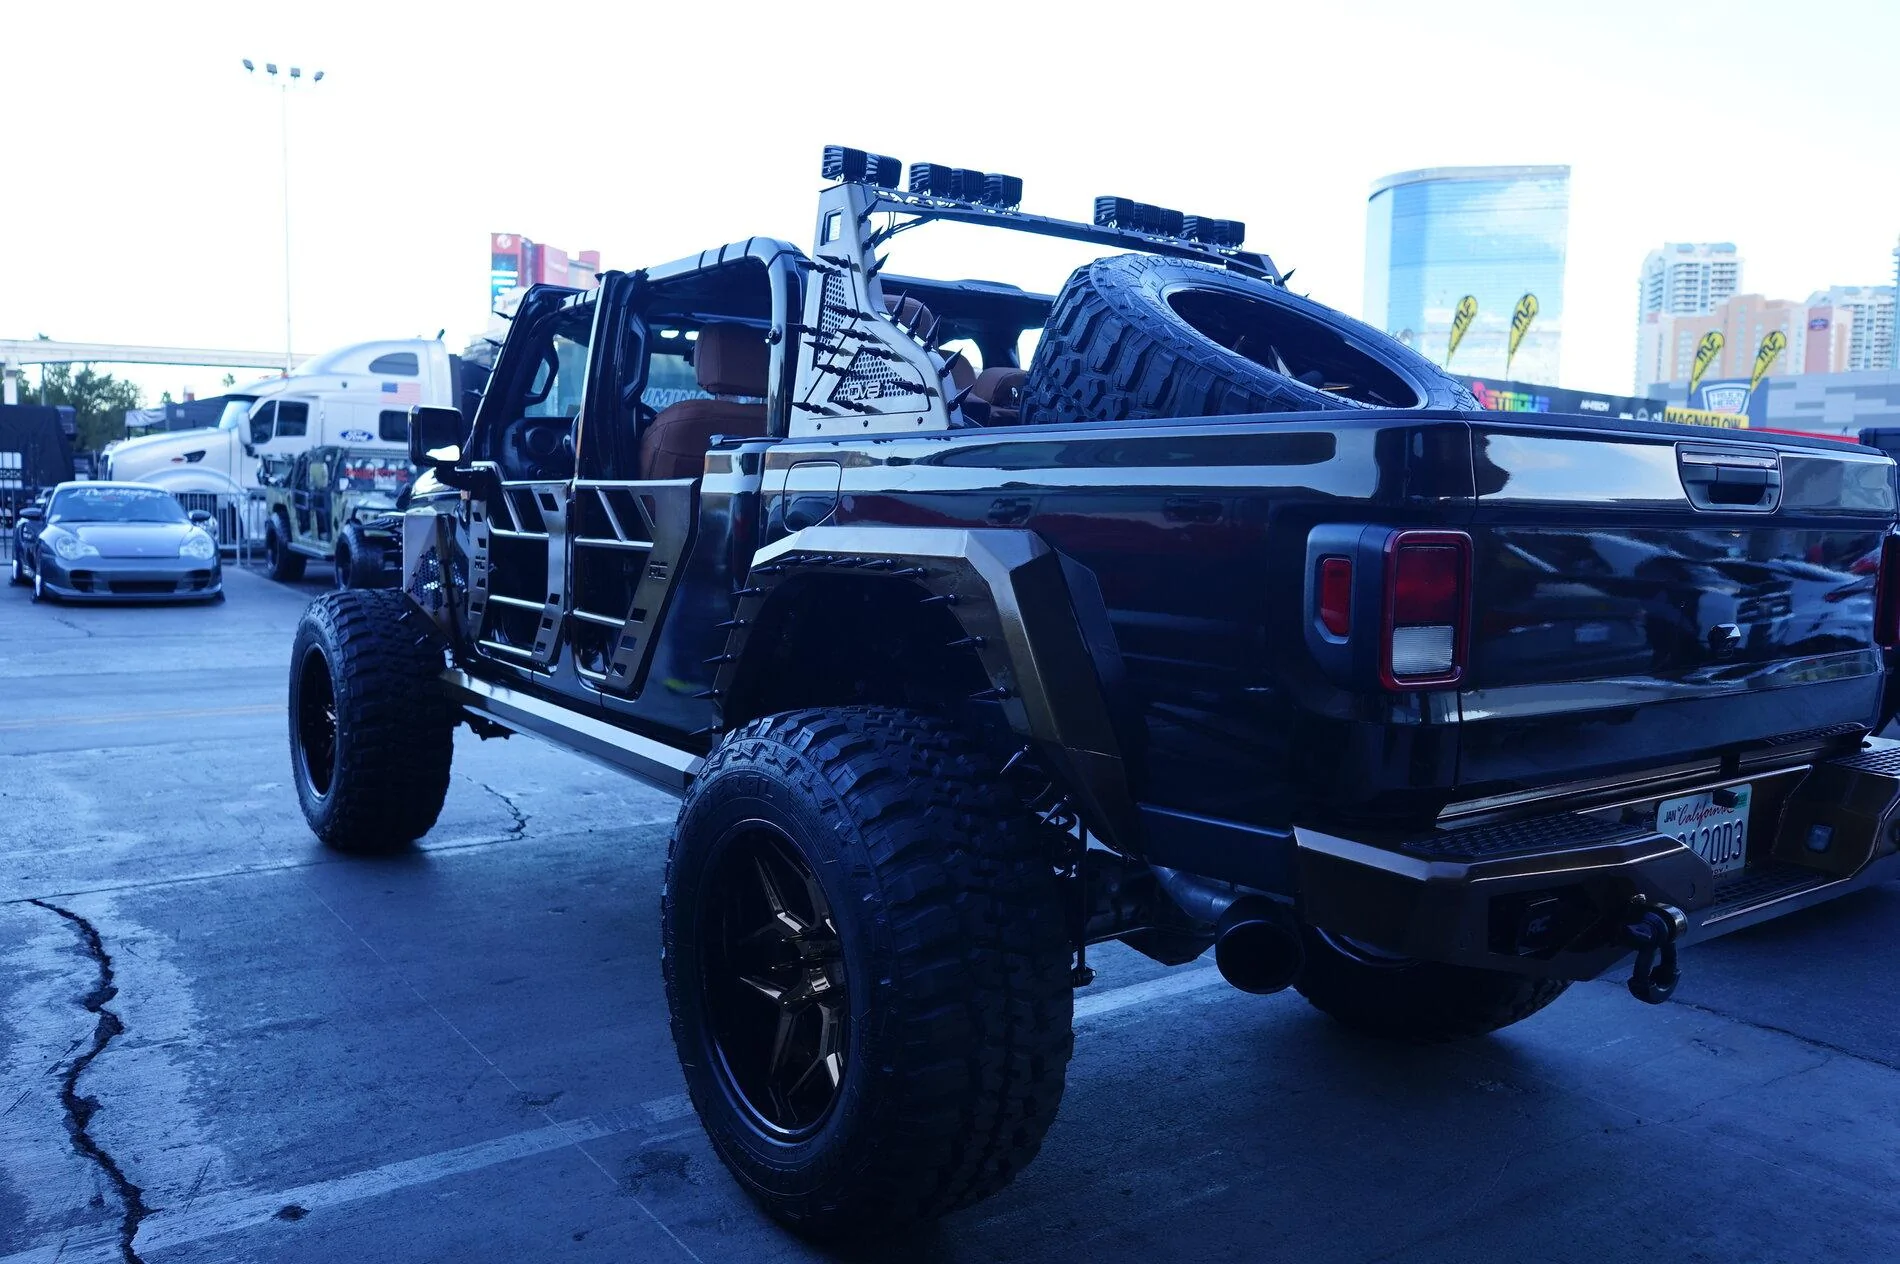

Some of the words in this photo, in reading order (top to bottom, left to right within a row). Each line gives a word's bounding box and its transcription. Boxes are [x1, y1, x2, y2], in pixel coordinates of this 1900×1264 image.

[1667, 412, 1741, 428] MAGNAFLOW
[1664, 809, 1677, 823] JAN
[1678, 801, 1734, 828] California
